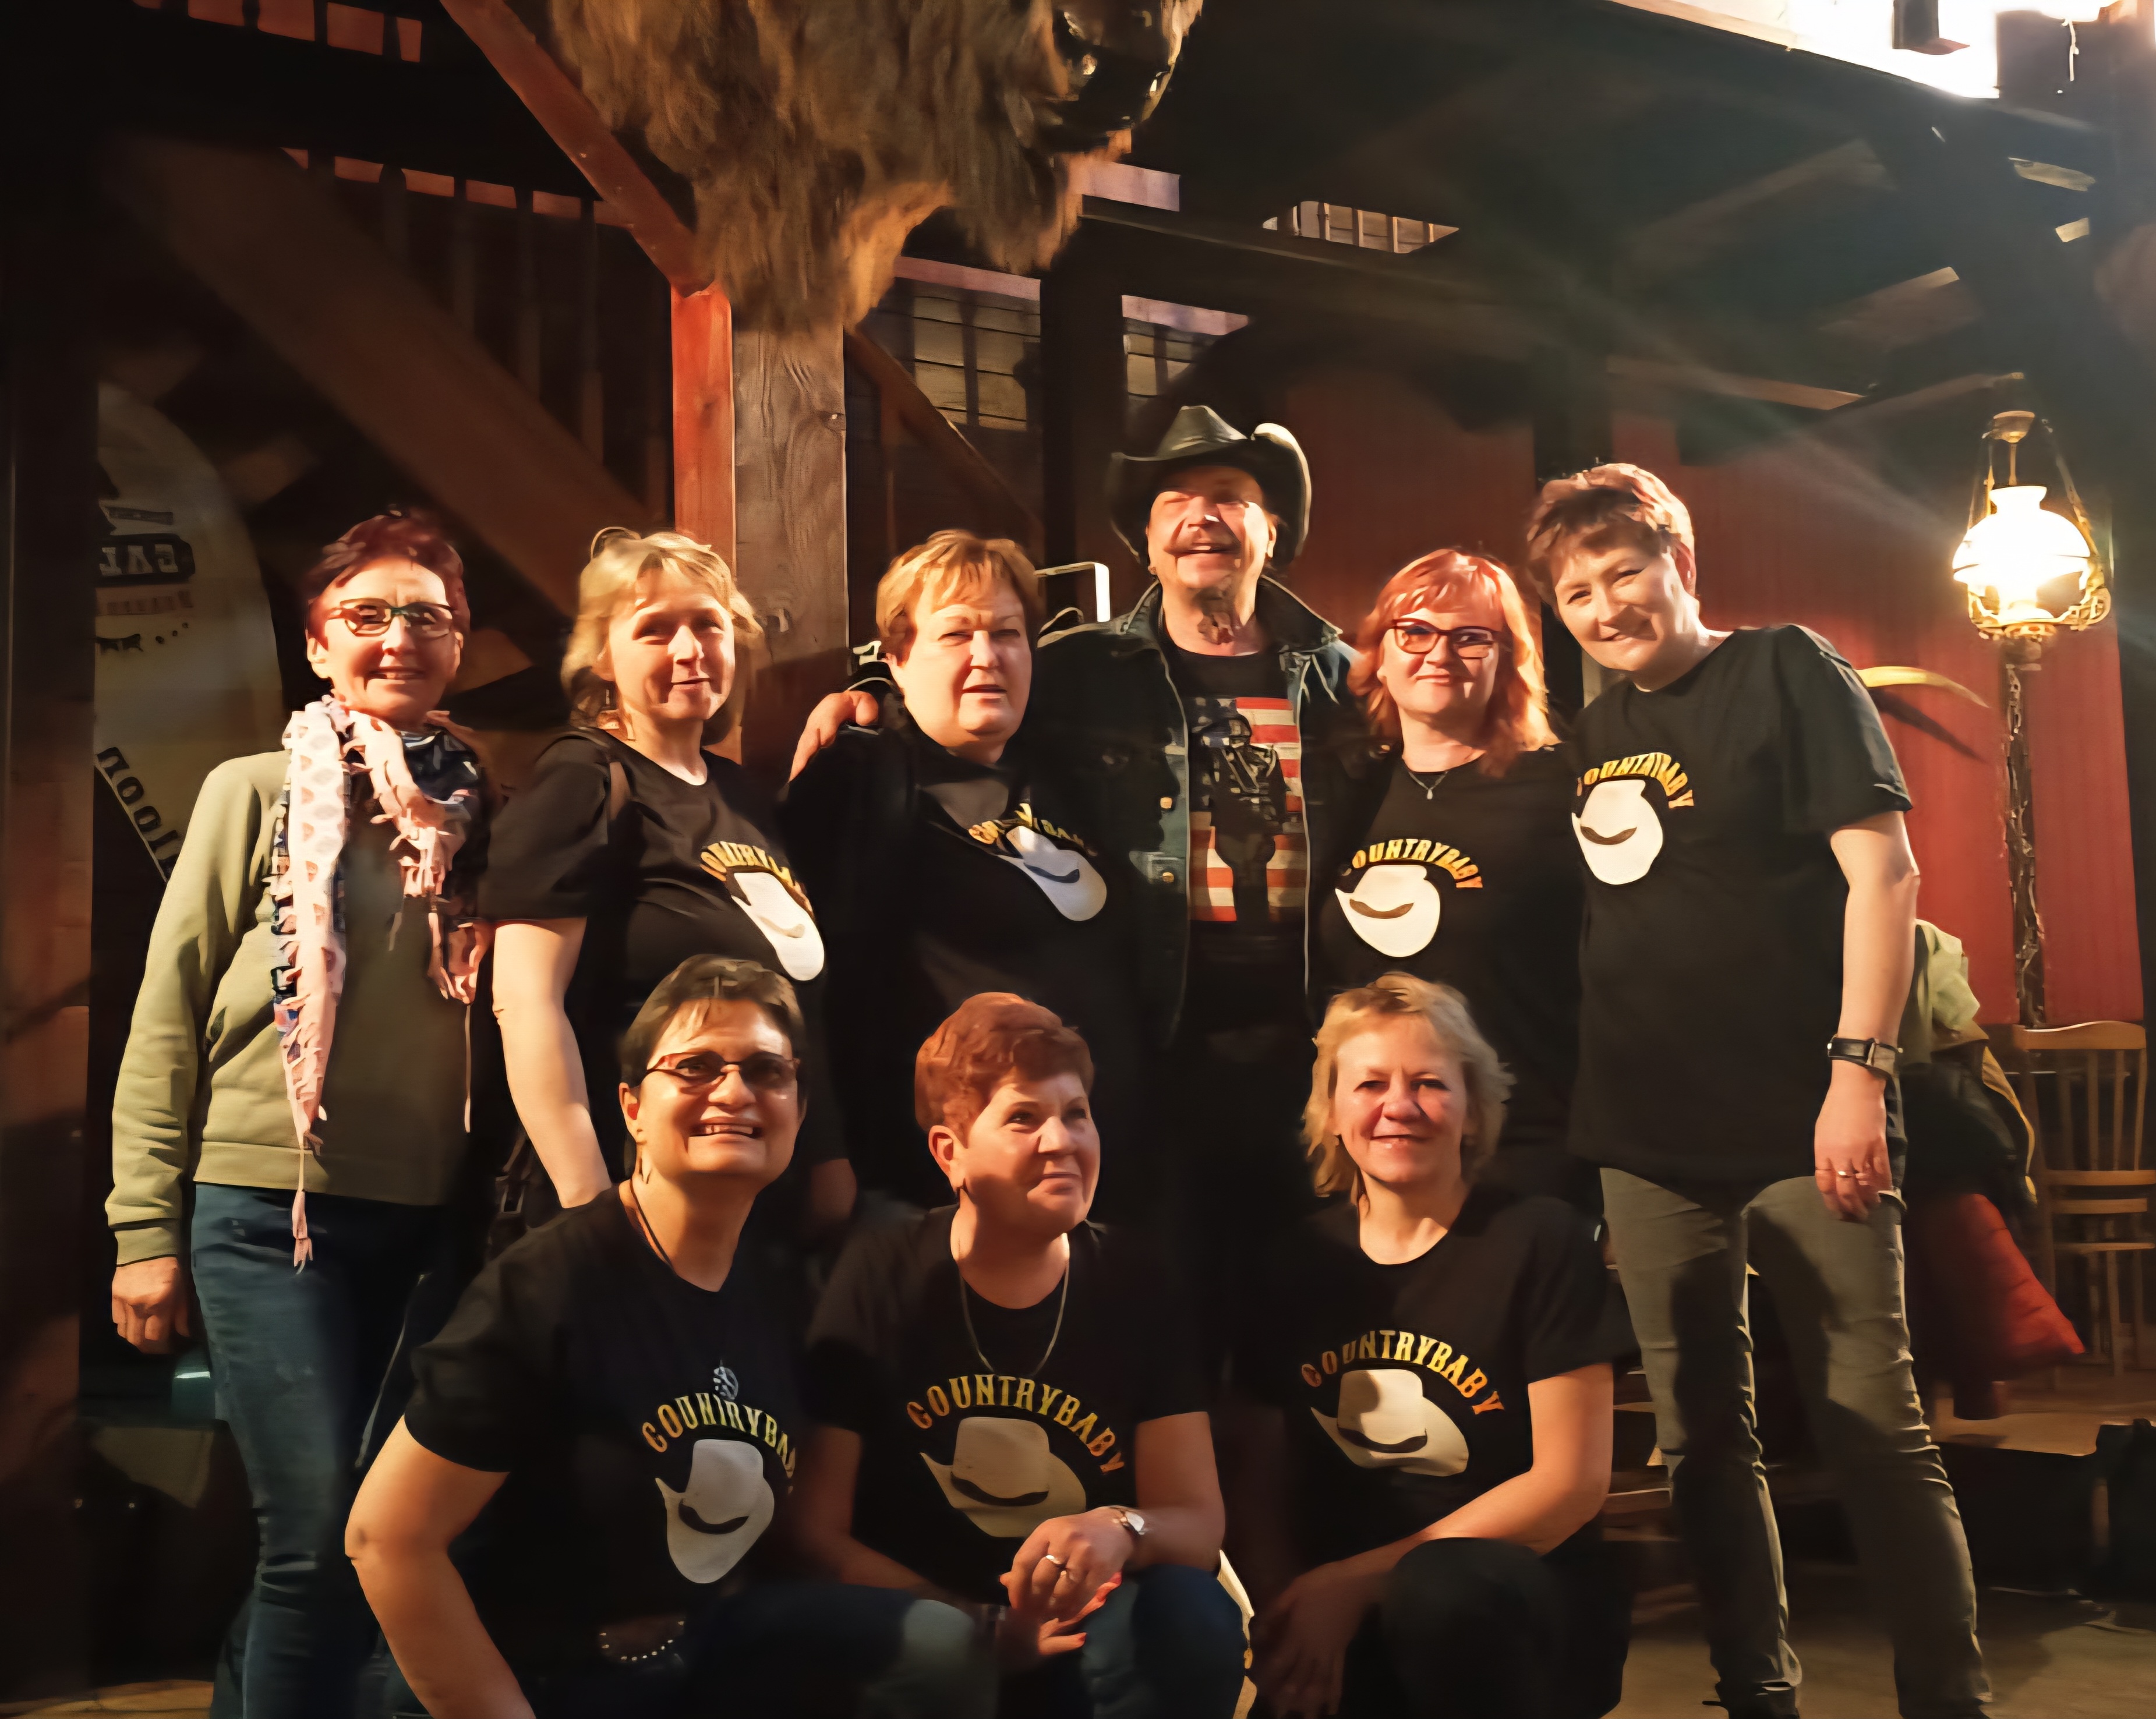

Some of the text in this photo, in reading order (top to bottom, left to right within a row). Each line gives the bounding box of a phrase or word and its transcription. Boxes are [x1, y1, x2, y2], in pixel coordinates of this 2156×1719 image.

[1342, 838, 1483, 889] OUNTRYBABY
[1301, 1330, 1505, 1416] COUNTRYBABY
[906, 1374, 1125, 1473] COUNTRYBABY
